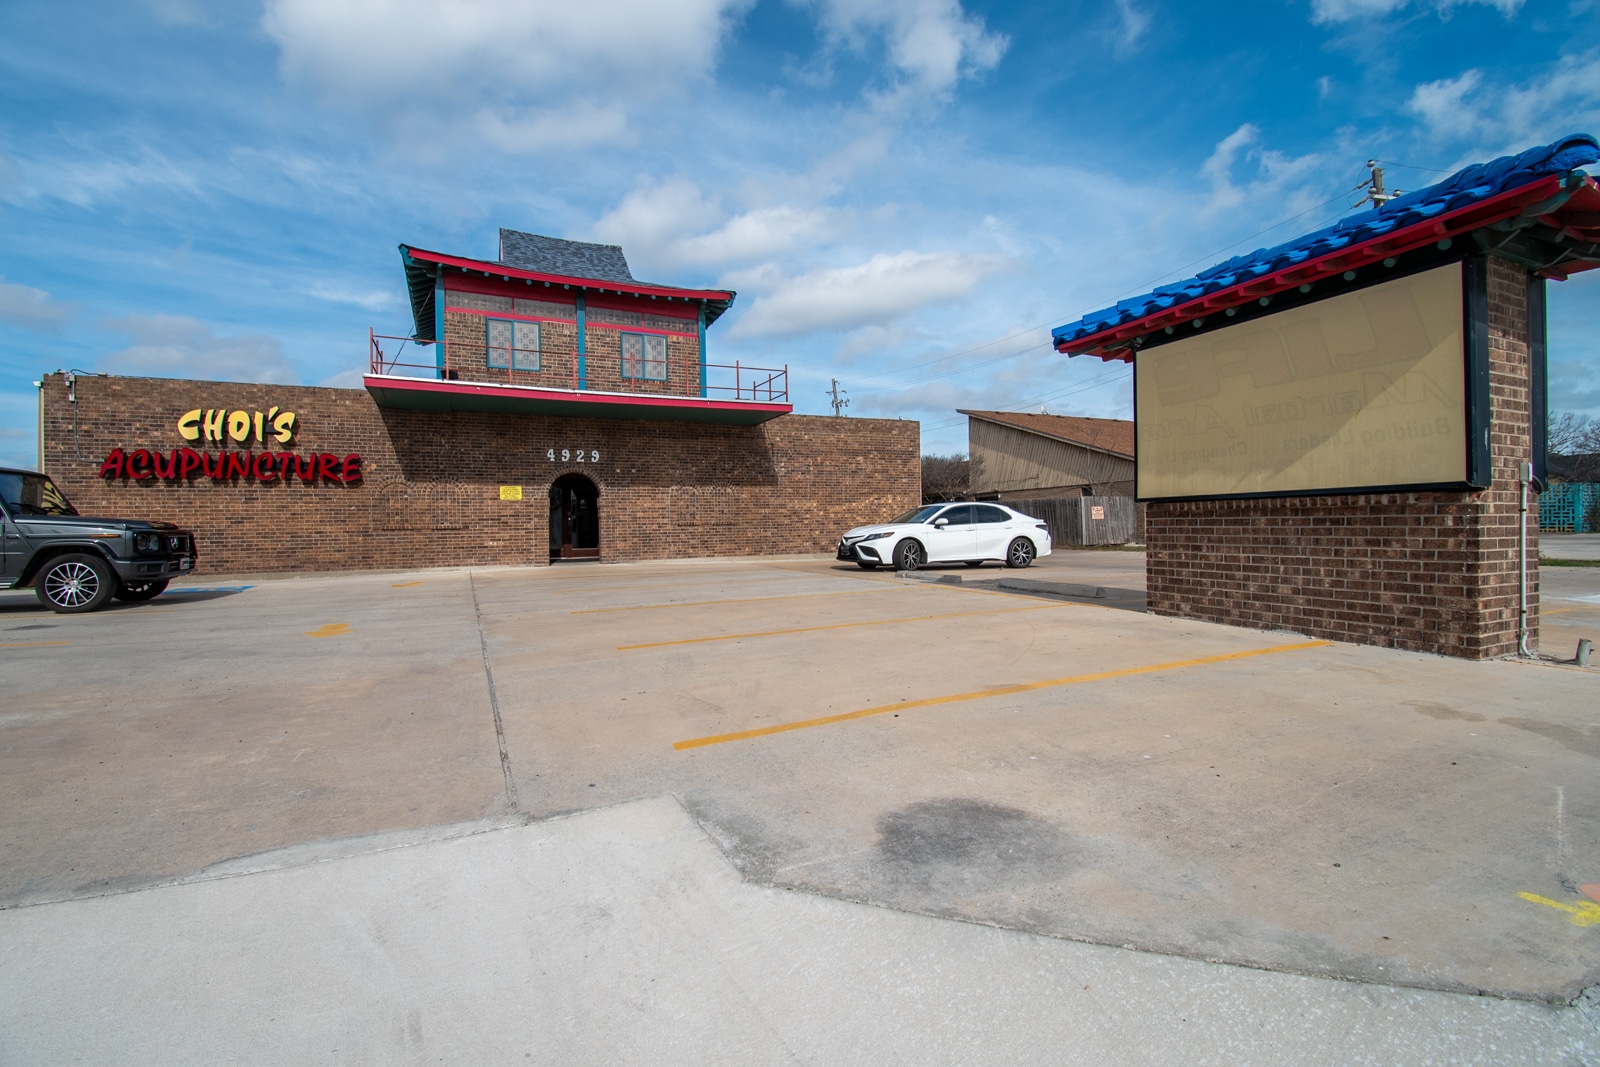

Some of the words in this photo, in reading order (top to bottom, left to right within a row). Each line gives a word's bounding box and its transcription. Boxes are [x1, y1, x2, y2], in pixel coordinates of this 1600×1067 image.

[177, 405, 296, 443] CHOI'S
[99, 447, 362, 481] ACUPUNCTURE
[547, 448, 600, 462] 4929
